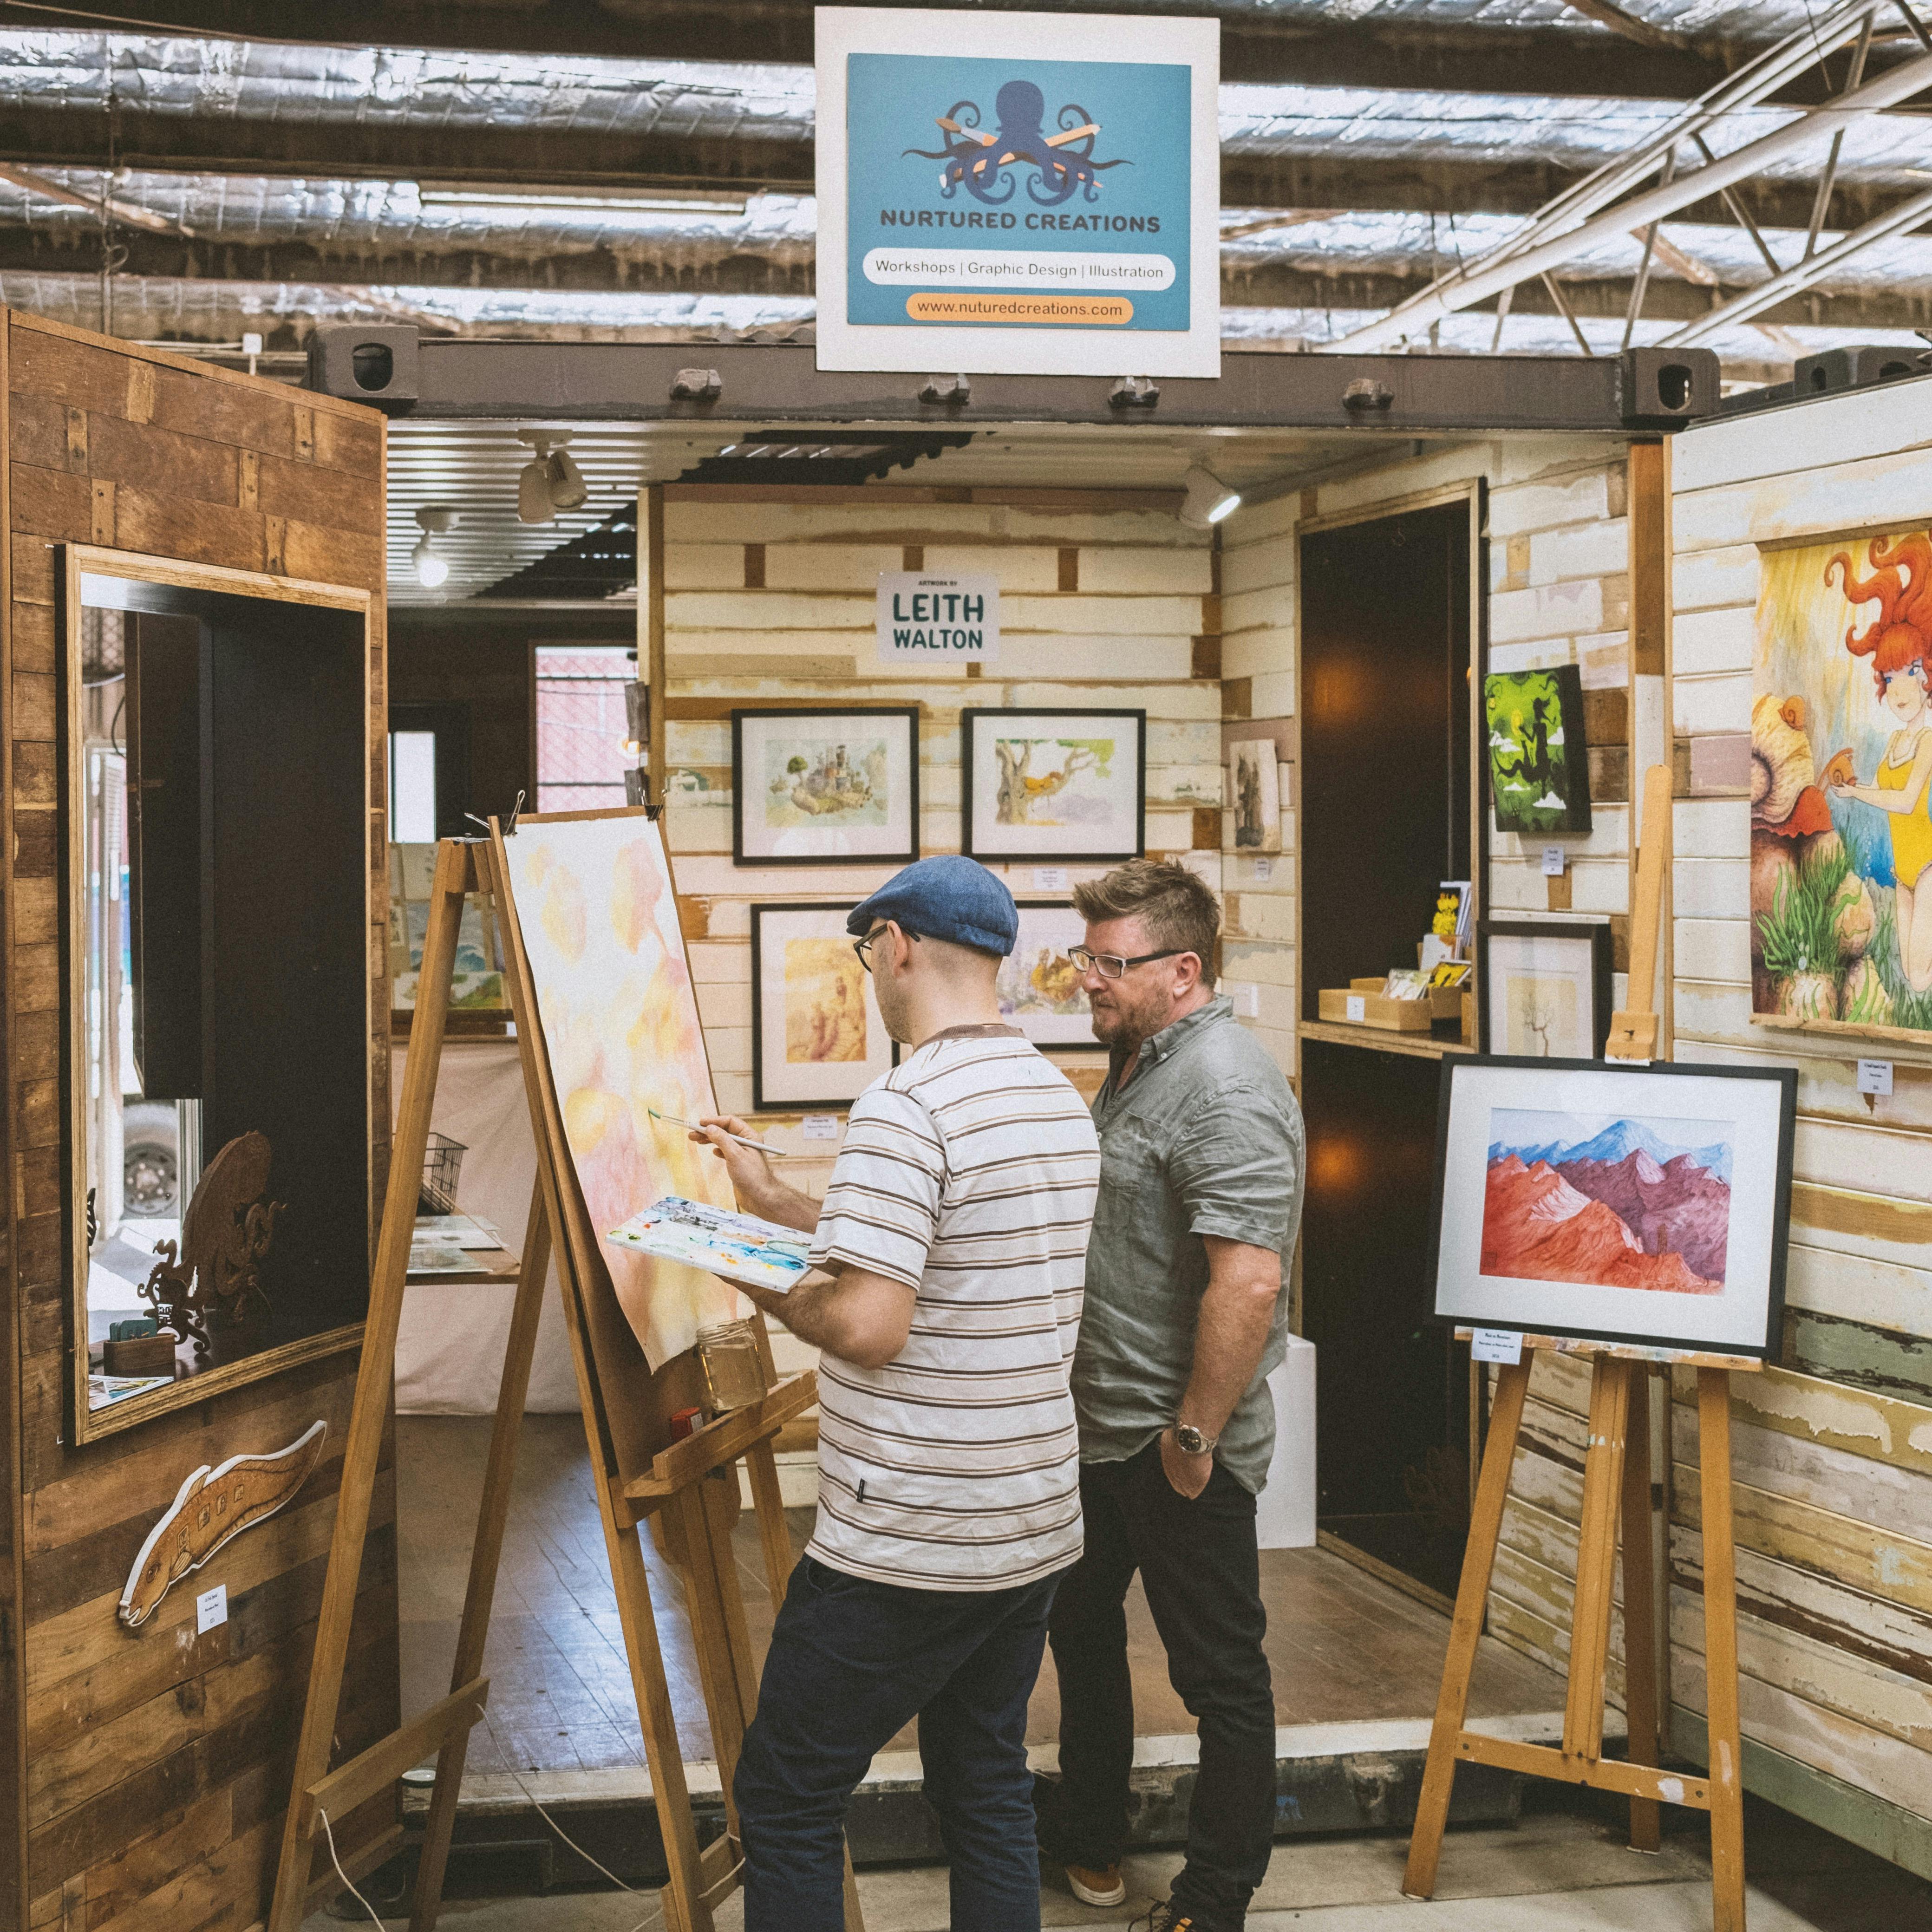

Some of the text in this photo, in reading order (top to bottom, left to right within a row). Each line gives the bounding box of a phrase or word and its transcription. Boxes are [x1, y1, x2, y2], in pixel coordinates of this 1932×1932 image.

[880, 209, 1161, 233] NURTURED CREATIONS
[875, 260, 1163, 279] Workshops Graphic Design Illustration
[917, 301, 1123, 316] www.nuturedcreations.com
[893, 593, 984, 622] LEITH
[893, 629, 983, 649] WALTON
